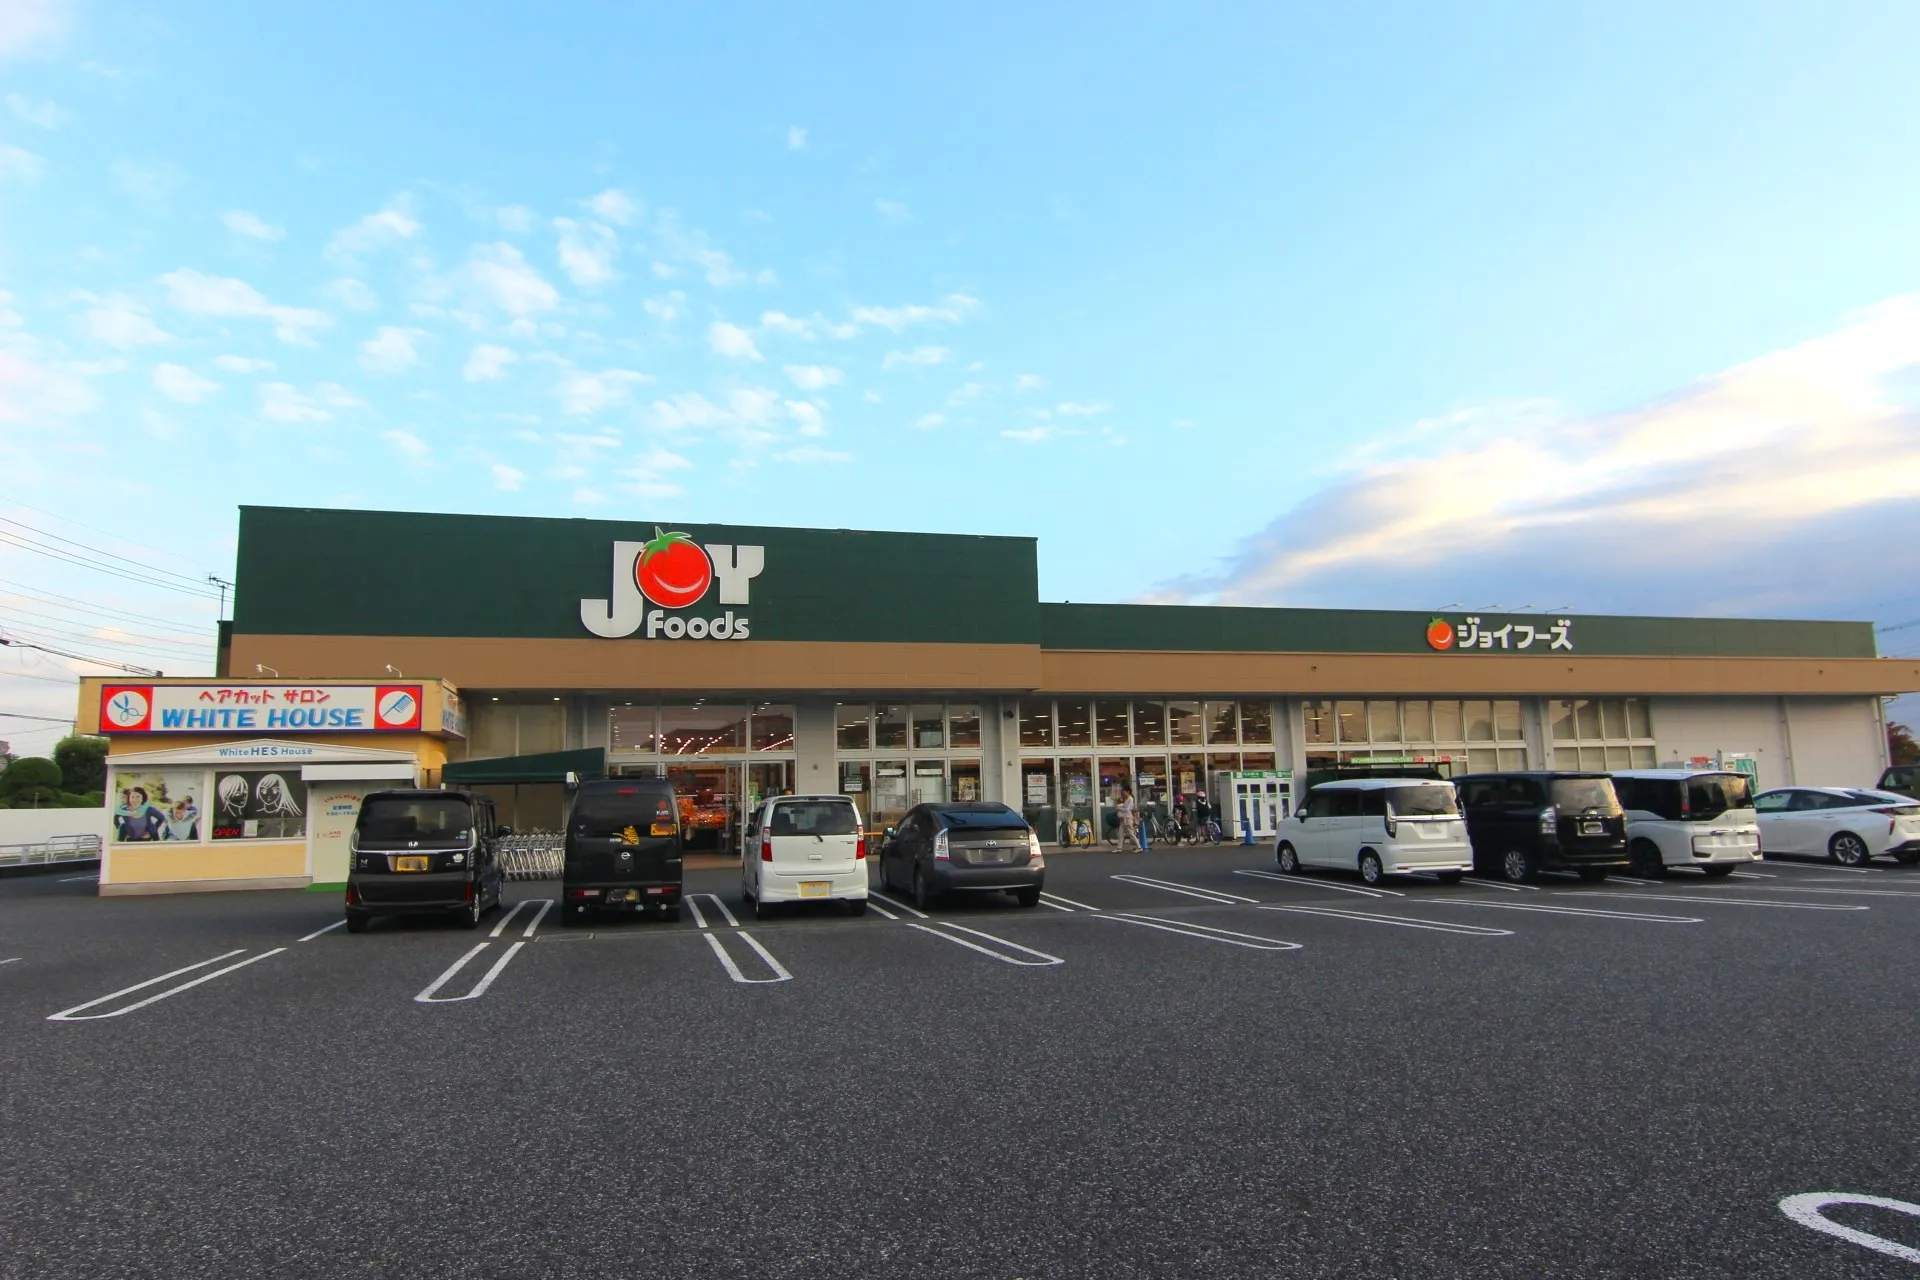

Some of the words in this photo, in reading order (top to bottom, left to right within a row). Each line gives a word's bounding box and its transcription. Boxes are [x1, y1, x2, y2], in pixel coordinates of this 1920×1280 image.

[1457, 617, 1573, 650] ジョイフーズ
[199, 689, 275, 704] ヘアカット
[283, 689, 331, 704] サロン
[161, 708, 257, 728] WHITE
[267, 708, 365, 728] HOUSE
[219, 748, 249, 757] White
[250, 746, 279, 756] HES
[281, 747, 313, 755] House
[214, 827, 240, 837] OPEN
